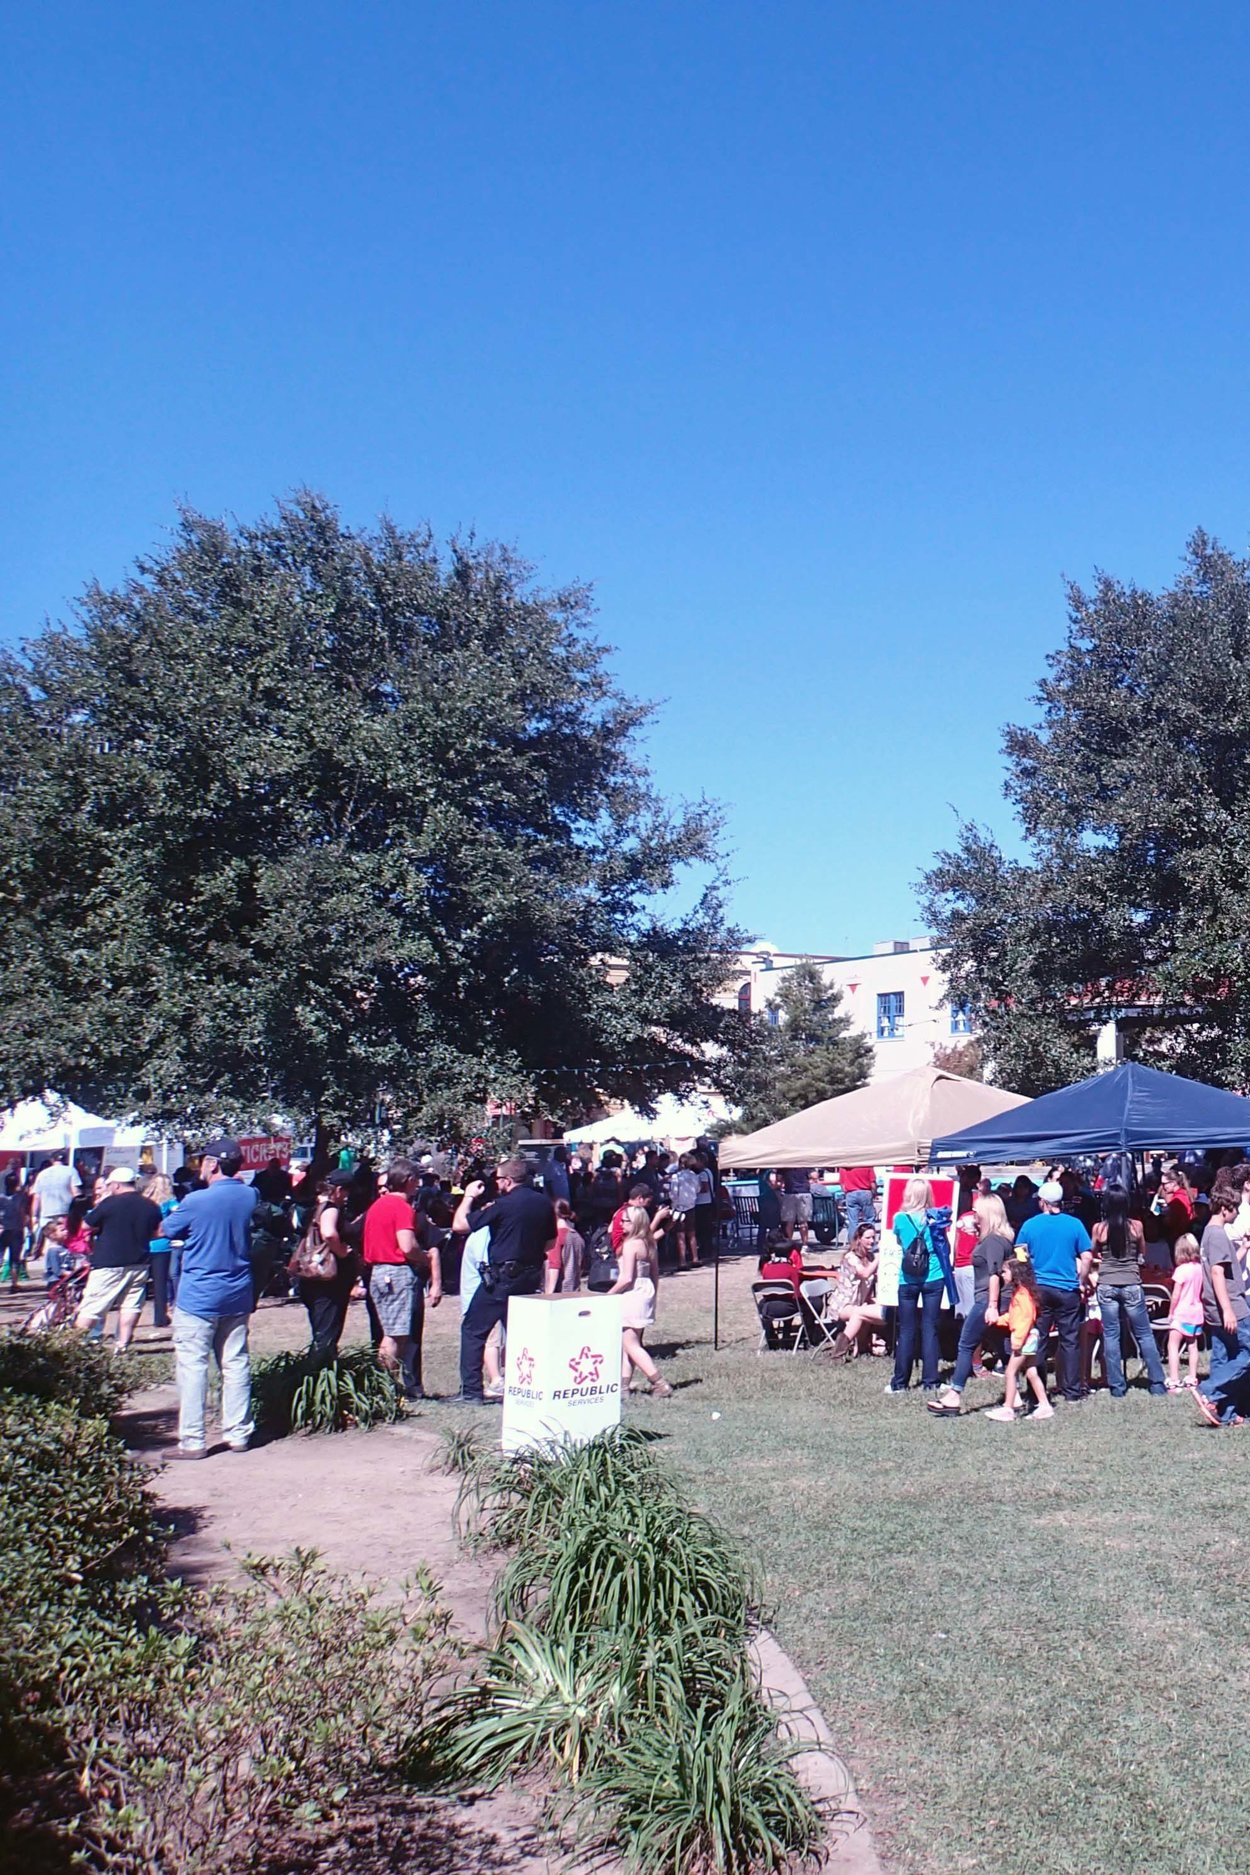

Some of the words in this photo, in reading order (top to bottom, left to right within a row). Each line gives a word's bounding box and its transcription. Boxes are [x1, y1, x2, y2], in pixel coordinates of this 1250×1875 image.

[508, 1386, 544, 1401] REPUBLIC
[552, 1383, 619, 1400] REPUBLIC
[567, 1396, 604, 1407] SERVICES
